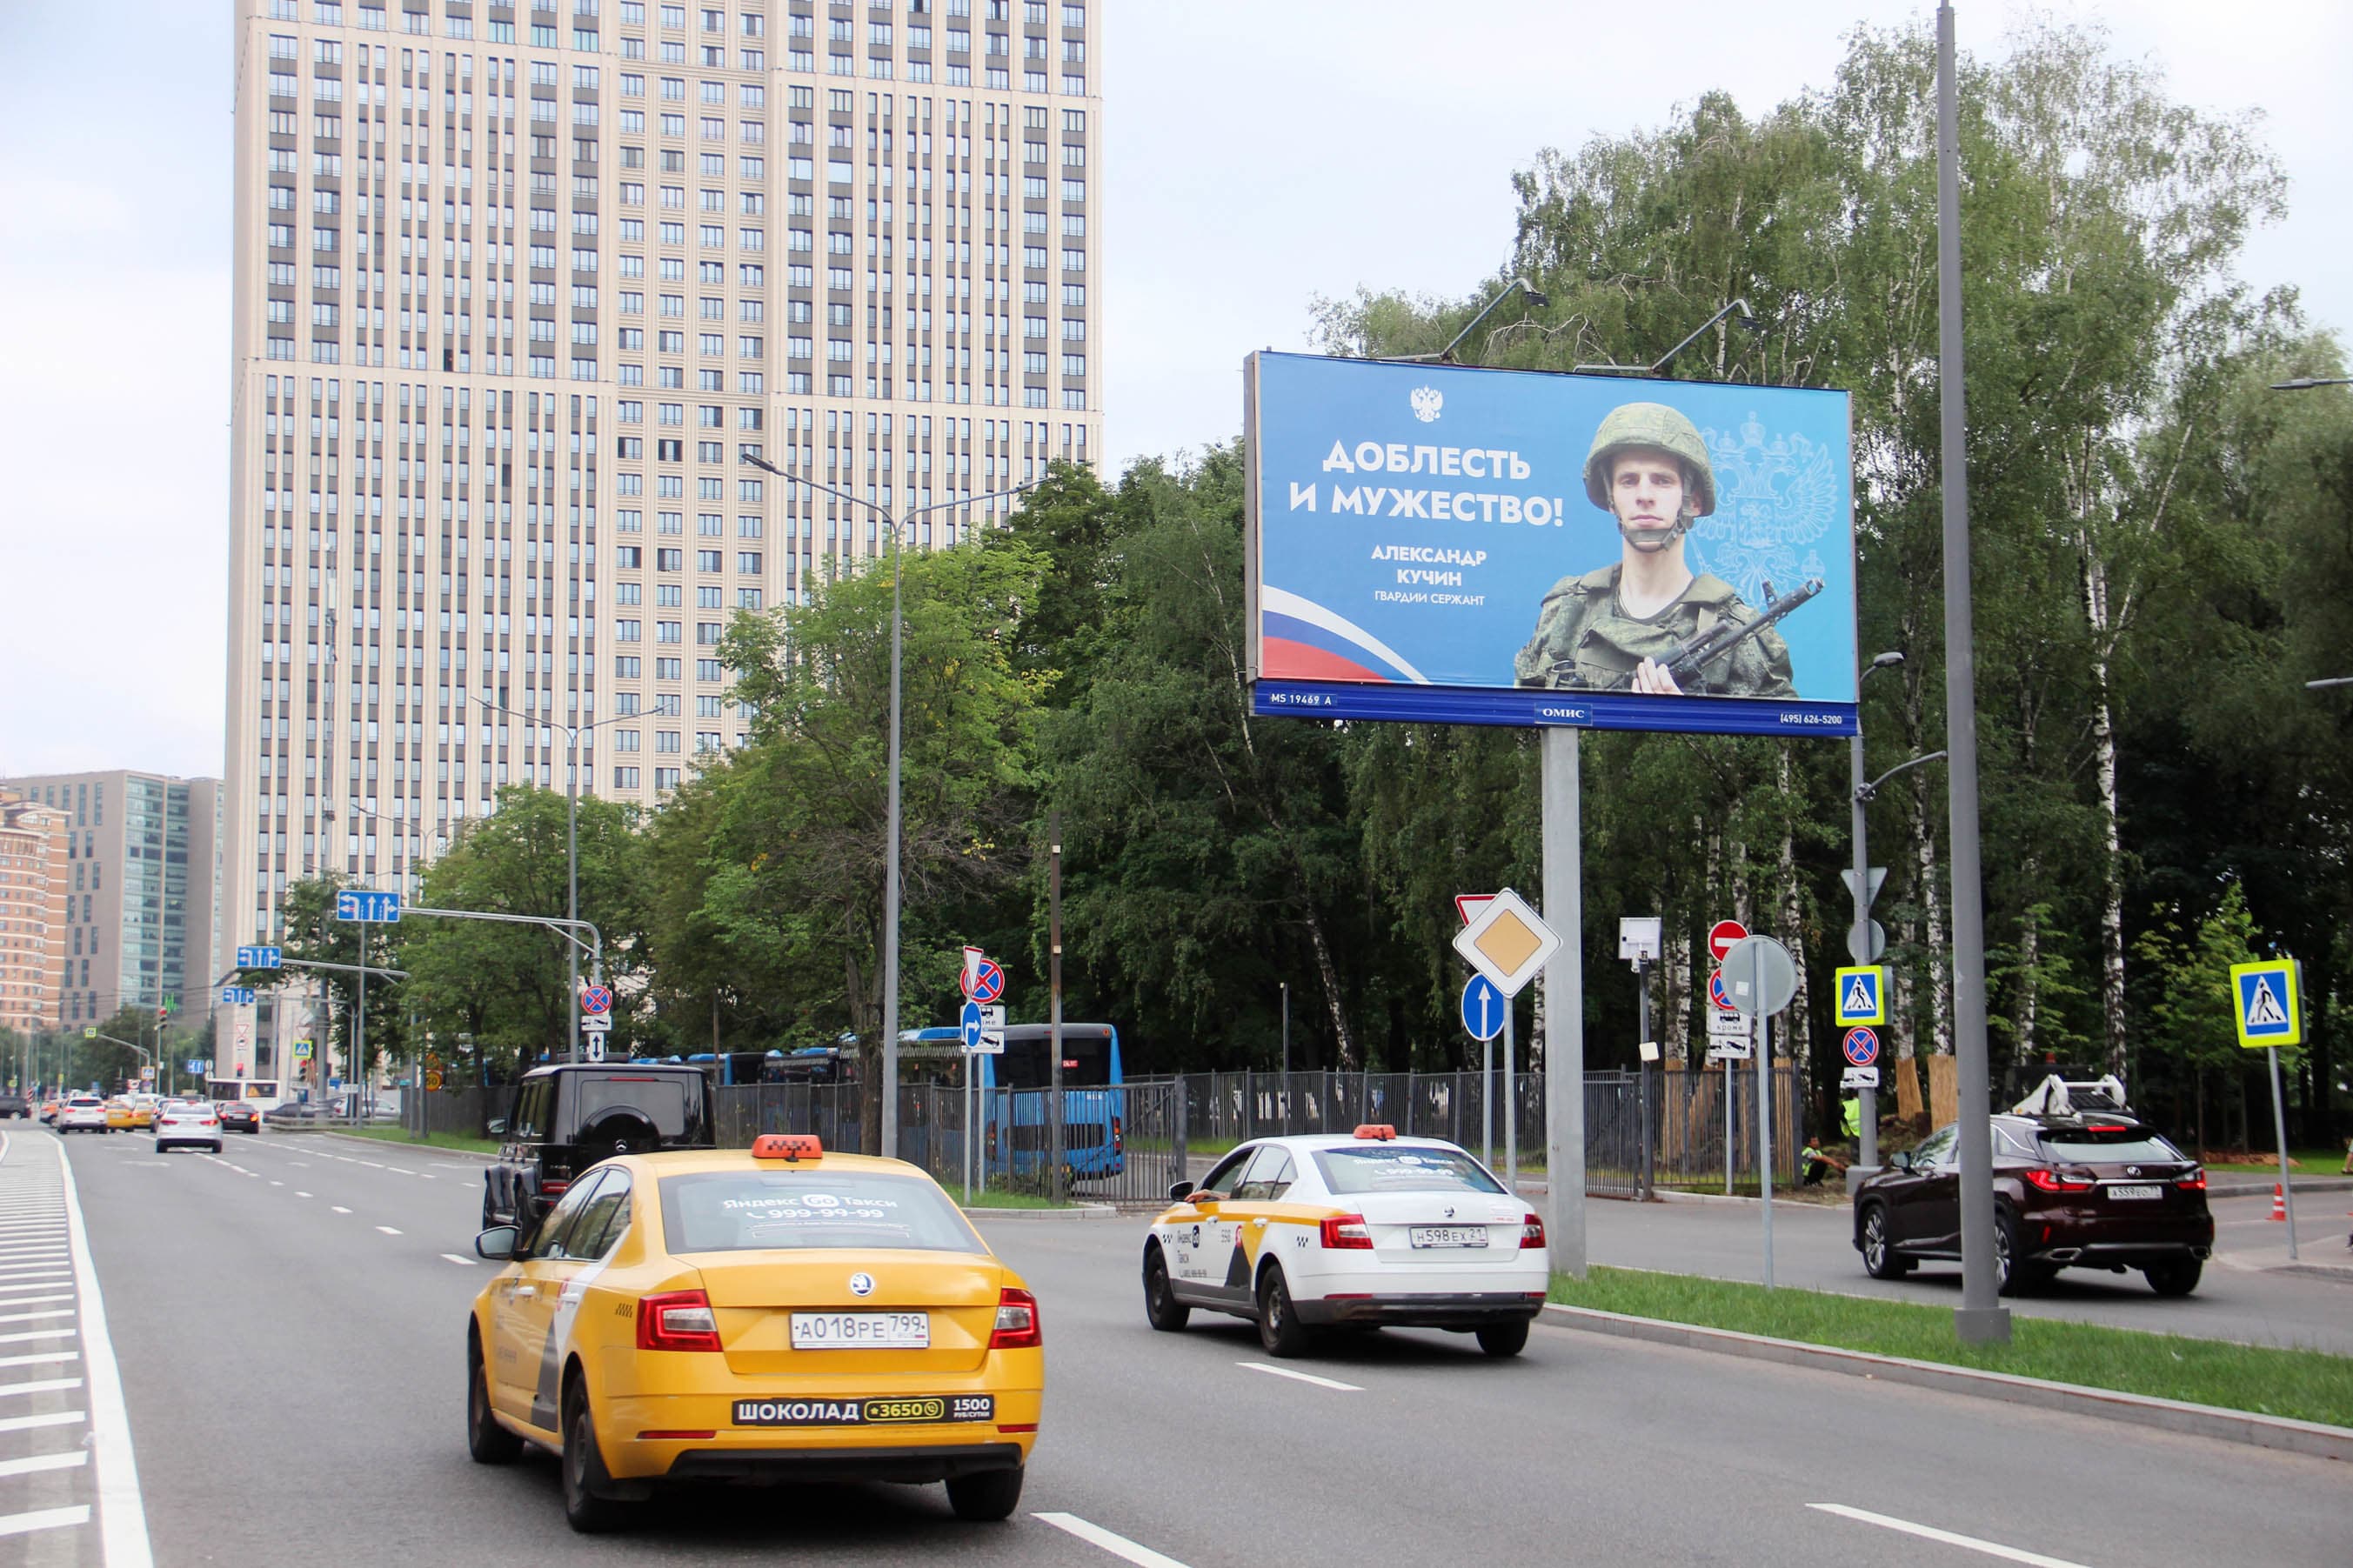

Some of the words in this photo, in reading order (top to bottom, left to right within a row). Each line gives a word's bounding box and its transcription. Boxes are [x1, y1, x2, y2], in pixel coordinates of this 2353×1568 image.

[1322, 439, 1531, 480] ДОБЛЕСТЬ
[1289, 482, 1317, 511] И
[1331, 484, 1564, 527] МУЖЕСТВО!
[1370, 545, 1487, 567] АЛЕКСАНДР
[1396, 569, 1462, 587] КУЧИН
[1374, 591, 1427, 604] ГВАРДИИ
[1430, 593, 1486, 606] СЕРЖАНТ
[1271, 693, 1287, 703] MS
[1289, 694, 1320, 705] 19469
[1780, 713, 1802, 724] (495)
[1803, 715, 1842, 724] 626-5200
[723, 1198, 799, 1209] Яндекс
[840, 1196, 898, 1208] Такси
[767, 1208, 885, 1218] 999-99-99
[739, 1403, 860, 1421] ШОКОЛАД
[953, 1398, 990, 1411] 1500
